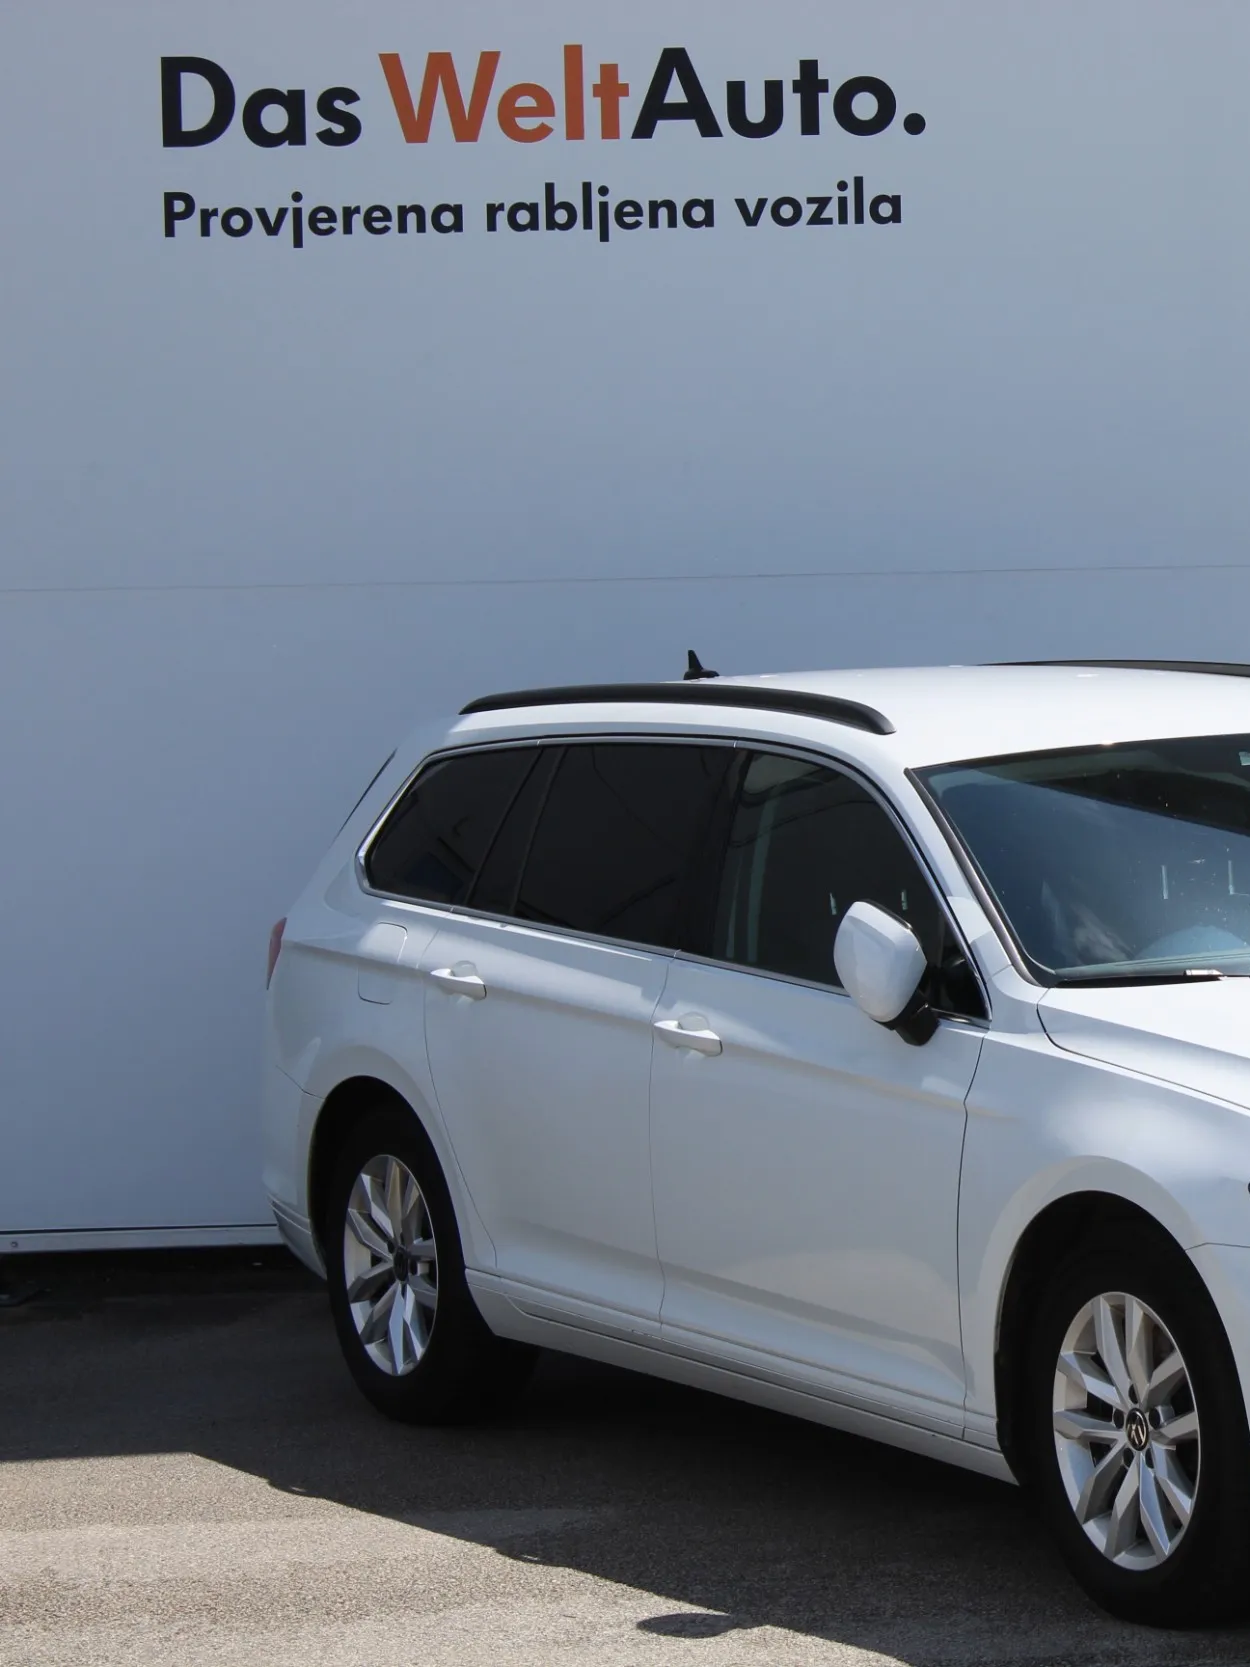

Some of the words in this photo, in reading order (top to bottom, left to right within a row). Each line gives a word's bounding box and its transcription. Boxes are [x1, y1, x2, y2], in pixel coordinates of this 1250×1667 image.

[160, 56, 362, 149] Das
[378, 43, 927, 144] WeltAuto.
[163, 191, 464, 249] Provjerena
[486, 181, 715, 243] rabljena
[734, 175, 902, 229] vozila
